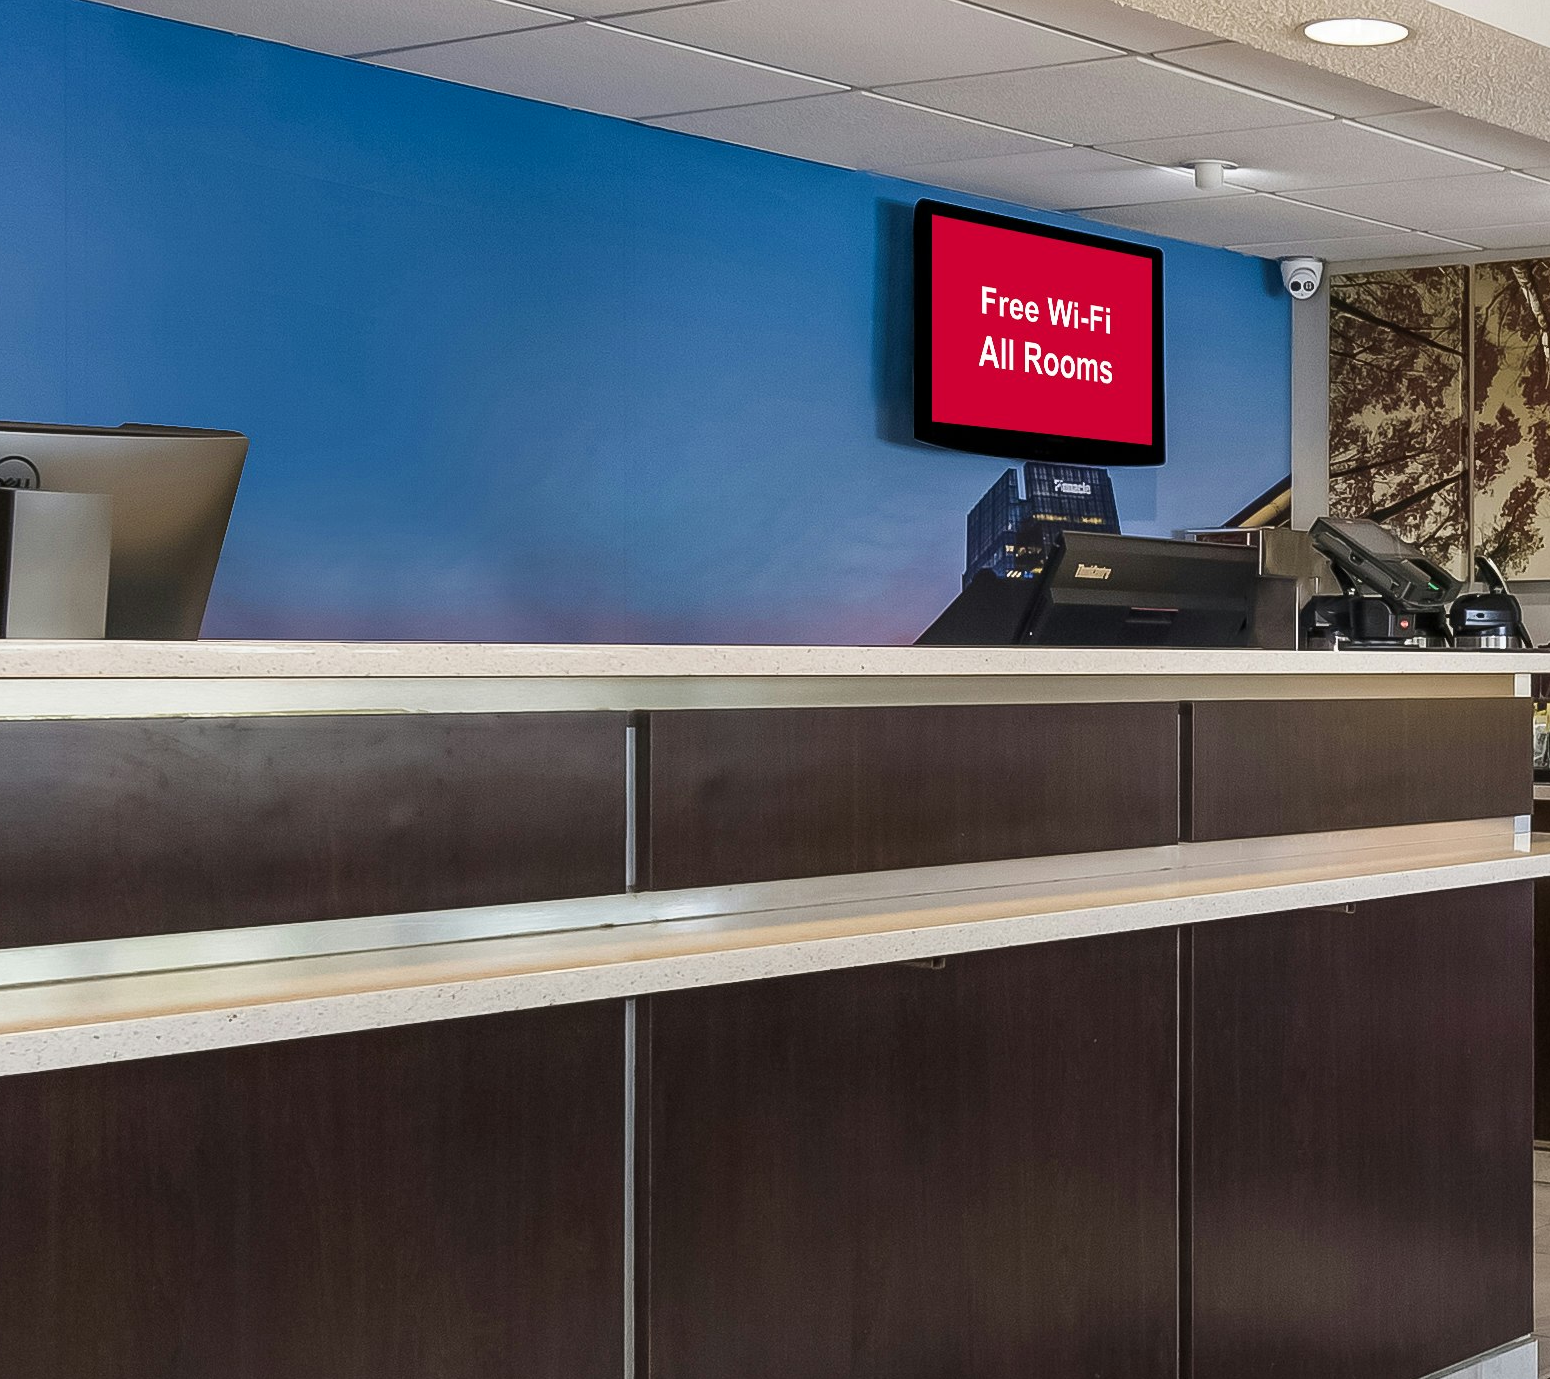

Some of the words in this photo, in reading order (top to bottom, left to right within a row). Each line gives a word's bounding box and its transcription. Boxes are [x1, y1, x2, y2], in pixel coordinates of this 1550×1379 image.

[981, 285, 1040, 323] Free
[1047, 297, 1112, 335] Wi-Fi
[978, 335, 1014, 371] All
[1024, 341, 1113, 385] Rooms
